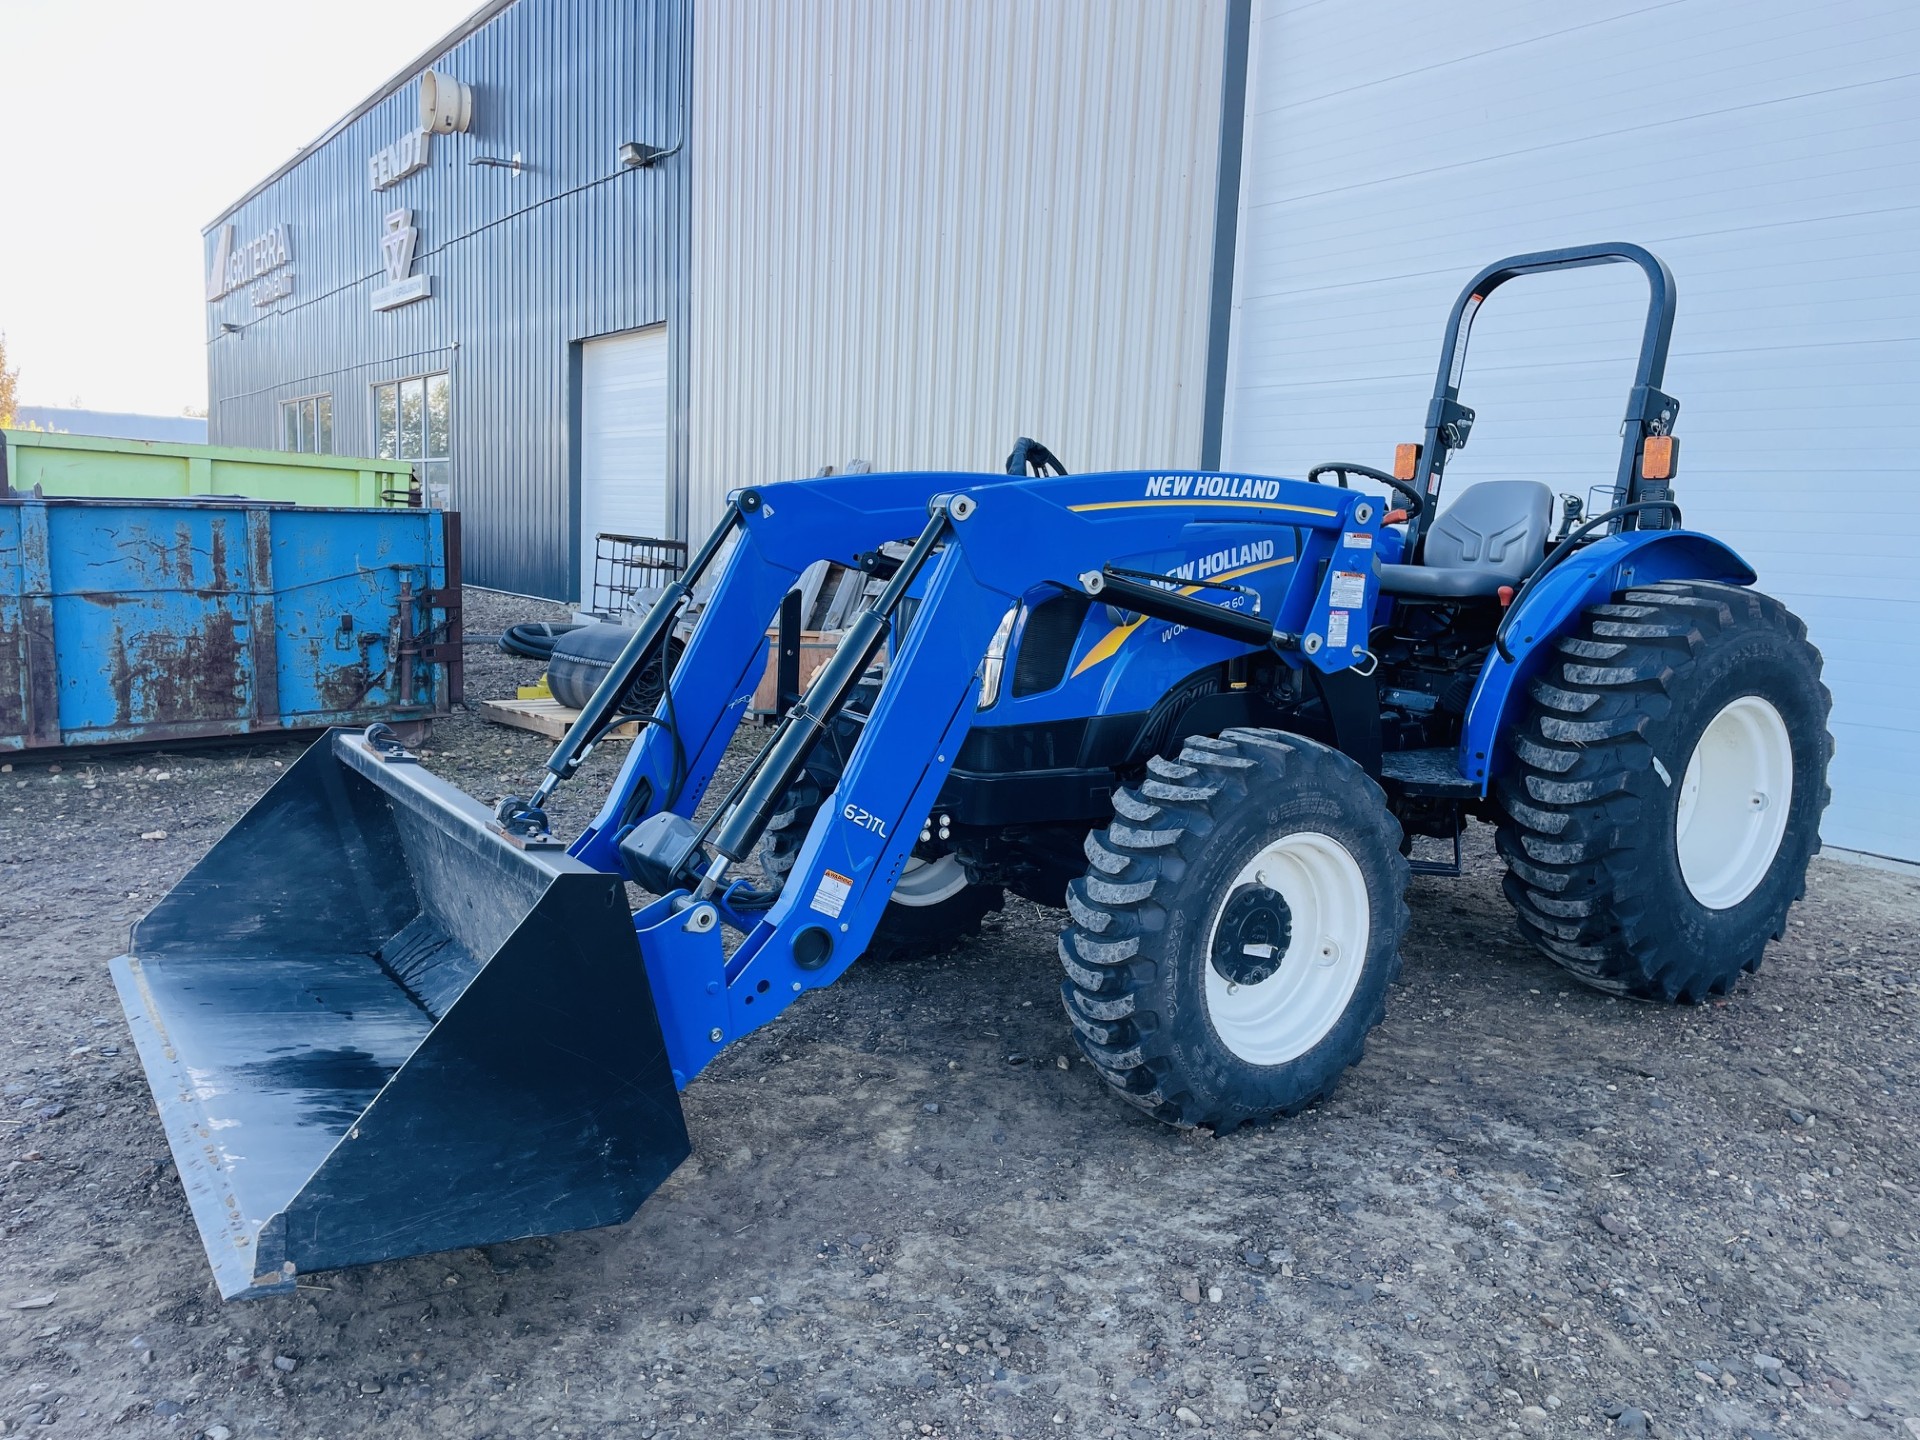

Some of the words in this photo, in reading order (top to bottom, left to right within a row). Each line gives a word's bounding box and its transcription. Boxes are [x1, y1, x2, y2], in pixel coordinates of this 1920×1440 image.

[369, 129, 430, 191] FENDT
[1145, 476, 1193, 497] NEW
[1193, 476, 1280, 500] HOLLAND
[1198, 540, 1274, 579] HOLLAND
[1231, 595, 1244, 609] 60
[844, 804, 886, 838] 621TL
